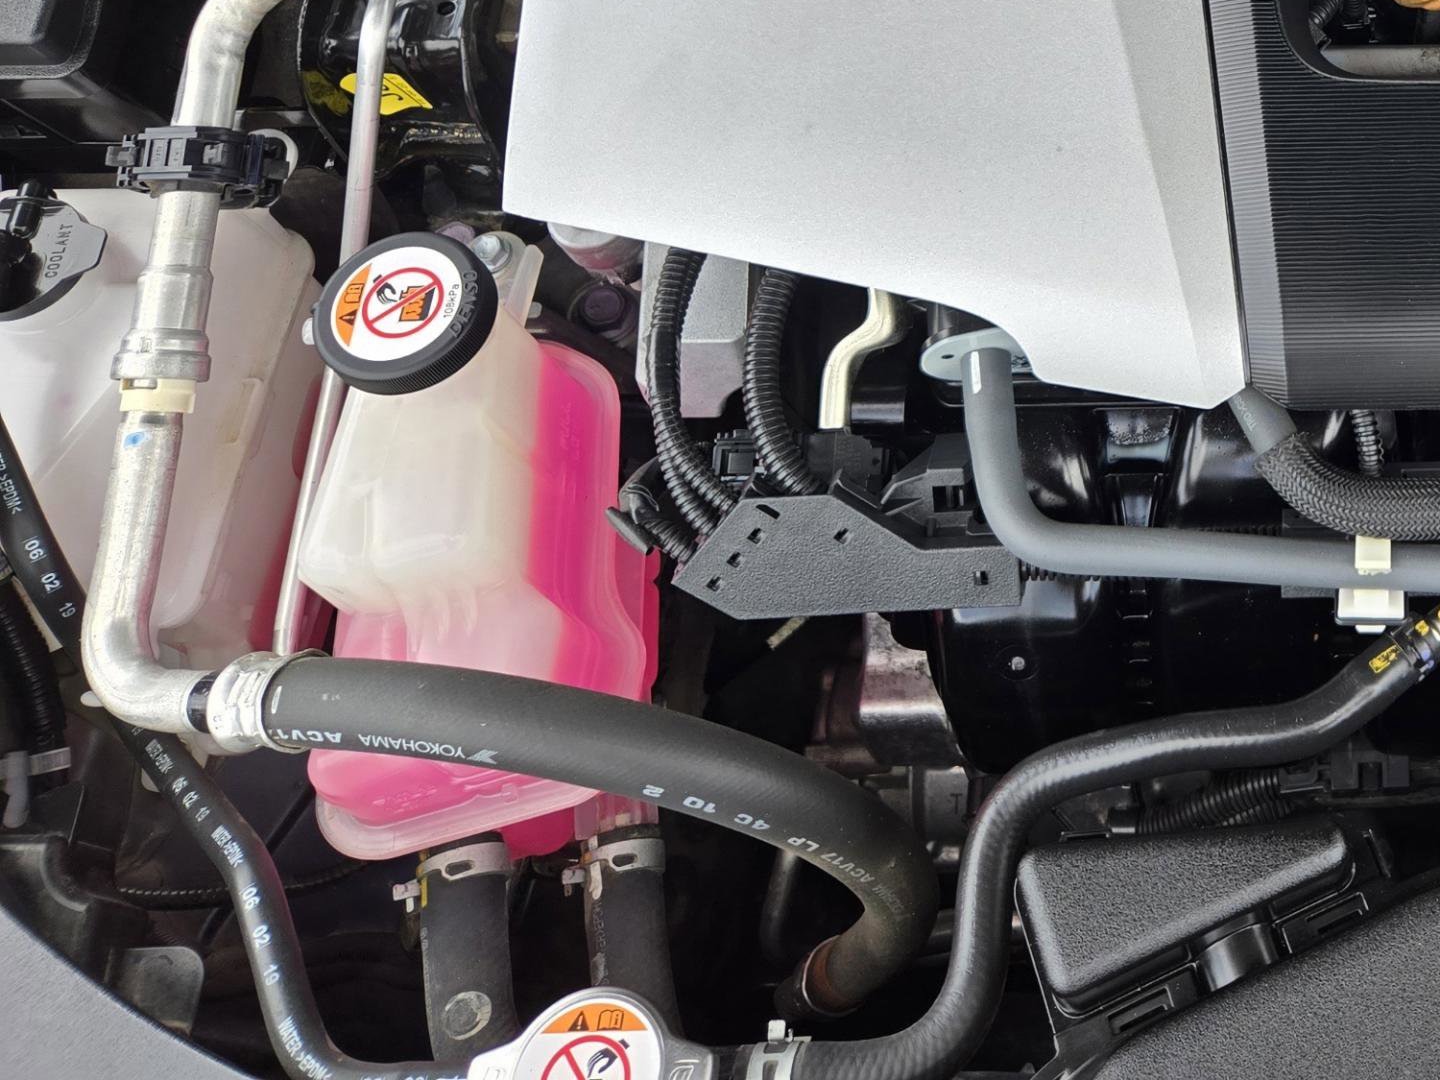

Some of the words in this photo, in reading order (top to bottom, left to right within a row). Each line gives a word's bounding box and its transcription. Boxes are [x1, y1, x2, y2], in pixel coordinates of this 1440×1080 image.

[44, 223, 73, 279] COOLANT
[450, 270, 479, 339] DENSO
[41, 572, 61, 594] 02
[58, 602, 76, 619] 19
[268, 727, 344, 744] ACV1
[357, 732, 467, 760] YOKOHAMA
[641, 784, 666, 799] 2
[682, 795, 718, 815] 10
[733, 812, 771, 831] 4C
[786, 835, 821, 853] LP
[819, 851, 876, 885] ACV17
[252, 924, 272, 948] 02
[263, 963, 281, 986] 19
